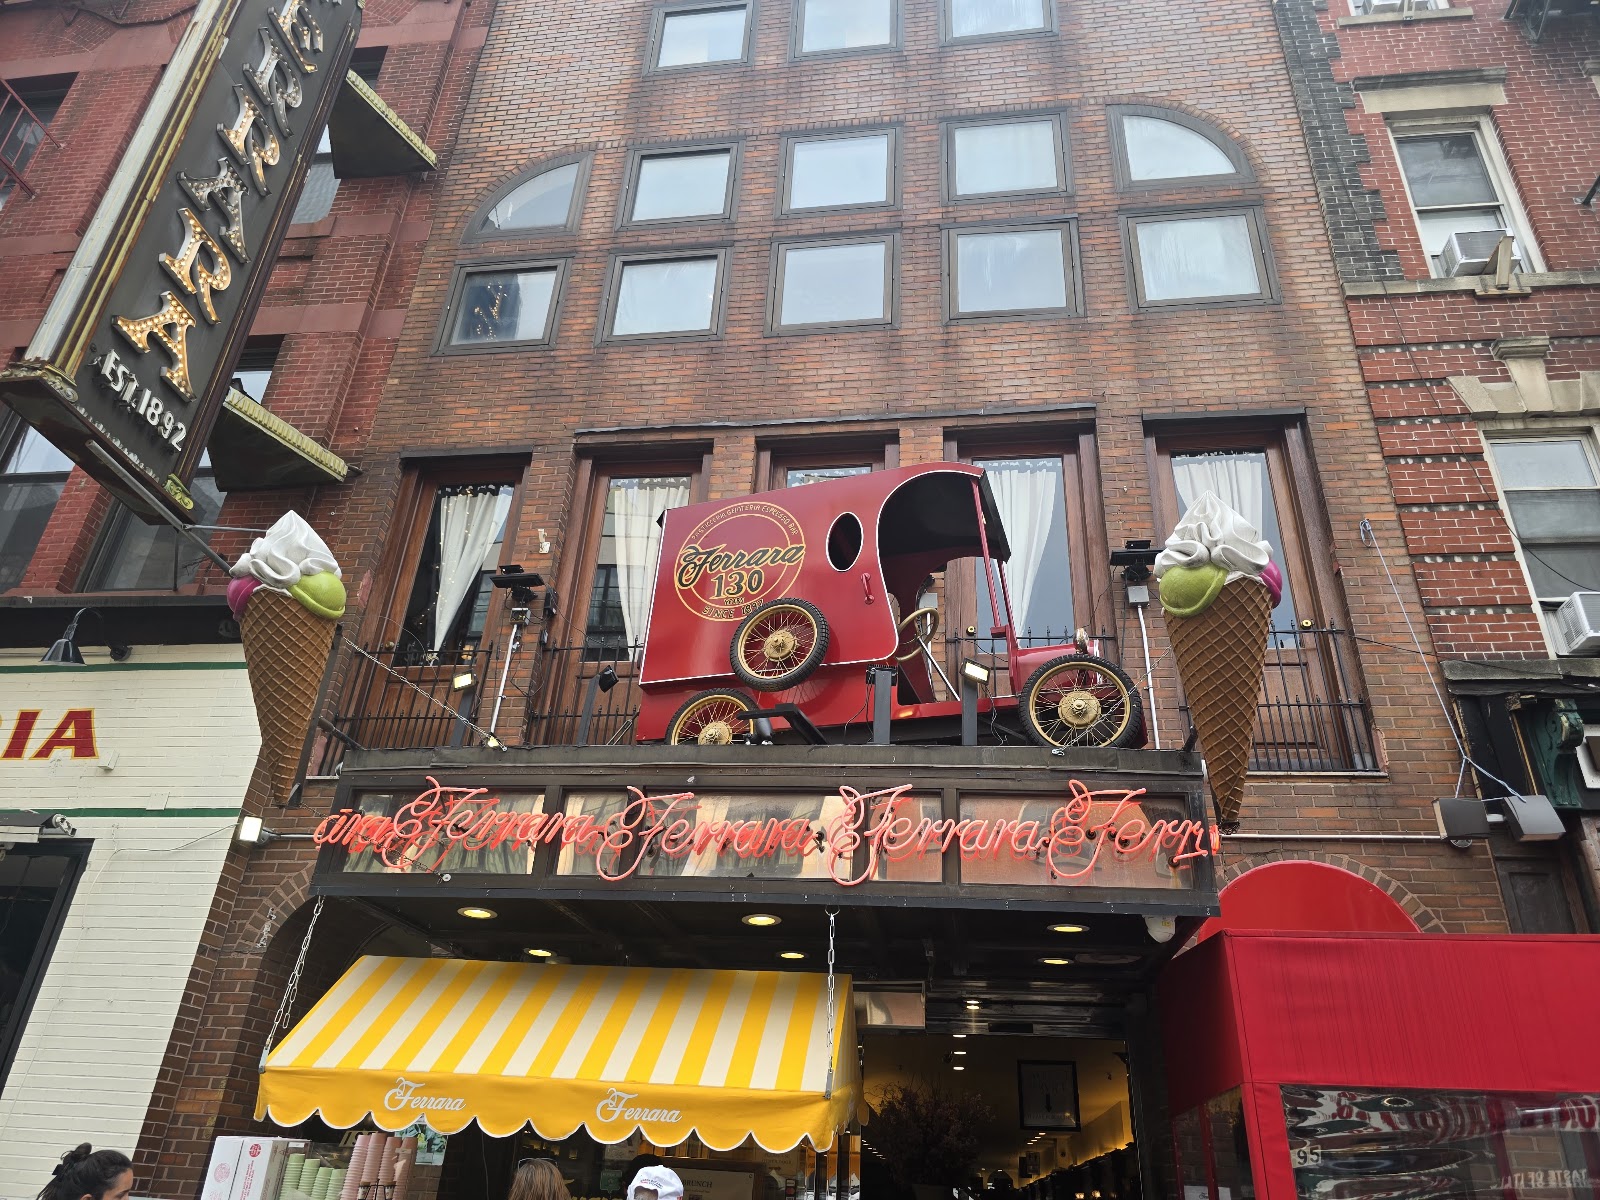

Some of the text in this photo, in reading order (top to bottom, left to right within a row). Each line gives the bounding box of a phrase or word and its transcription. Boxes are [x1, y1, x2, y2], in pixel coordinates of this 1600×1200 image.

[111, 0, 342, 402] ERRARA
[761, 505, 791, 525] ESPRESSO
[788, 522, 799, 536] BAR
[676, 543, 806, 590] Ferrara
[708, 568, 765, 600] 130
[702, 605, 736, 619] SINCE
[0, 708, 99, 760] IA
[382, 776, 599, 868] Ferrara
[596, 785, 822, 881] Ferrara
[826, 784, 1049, 886] Ferrara
[384, 1076, 466, 1111] Ferrara
[596, 1087, 682, 1123] Ferrara
